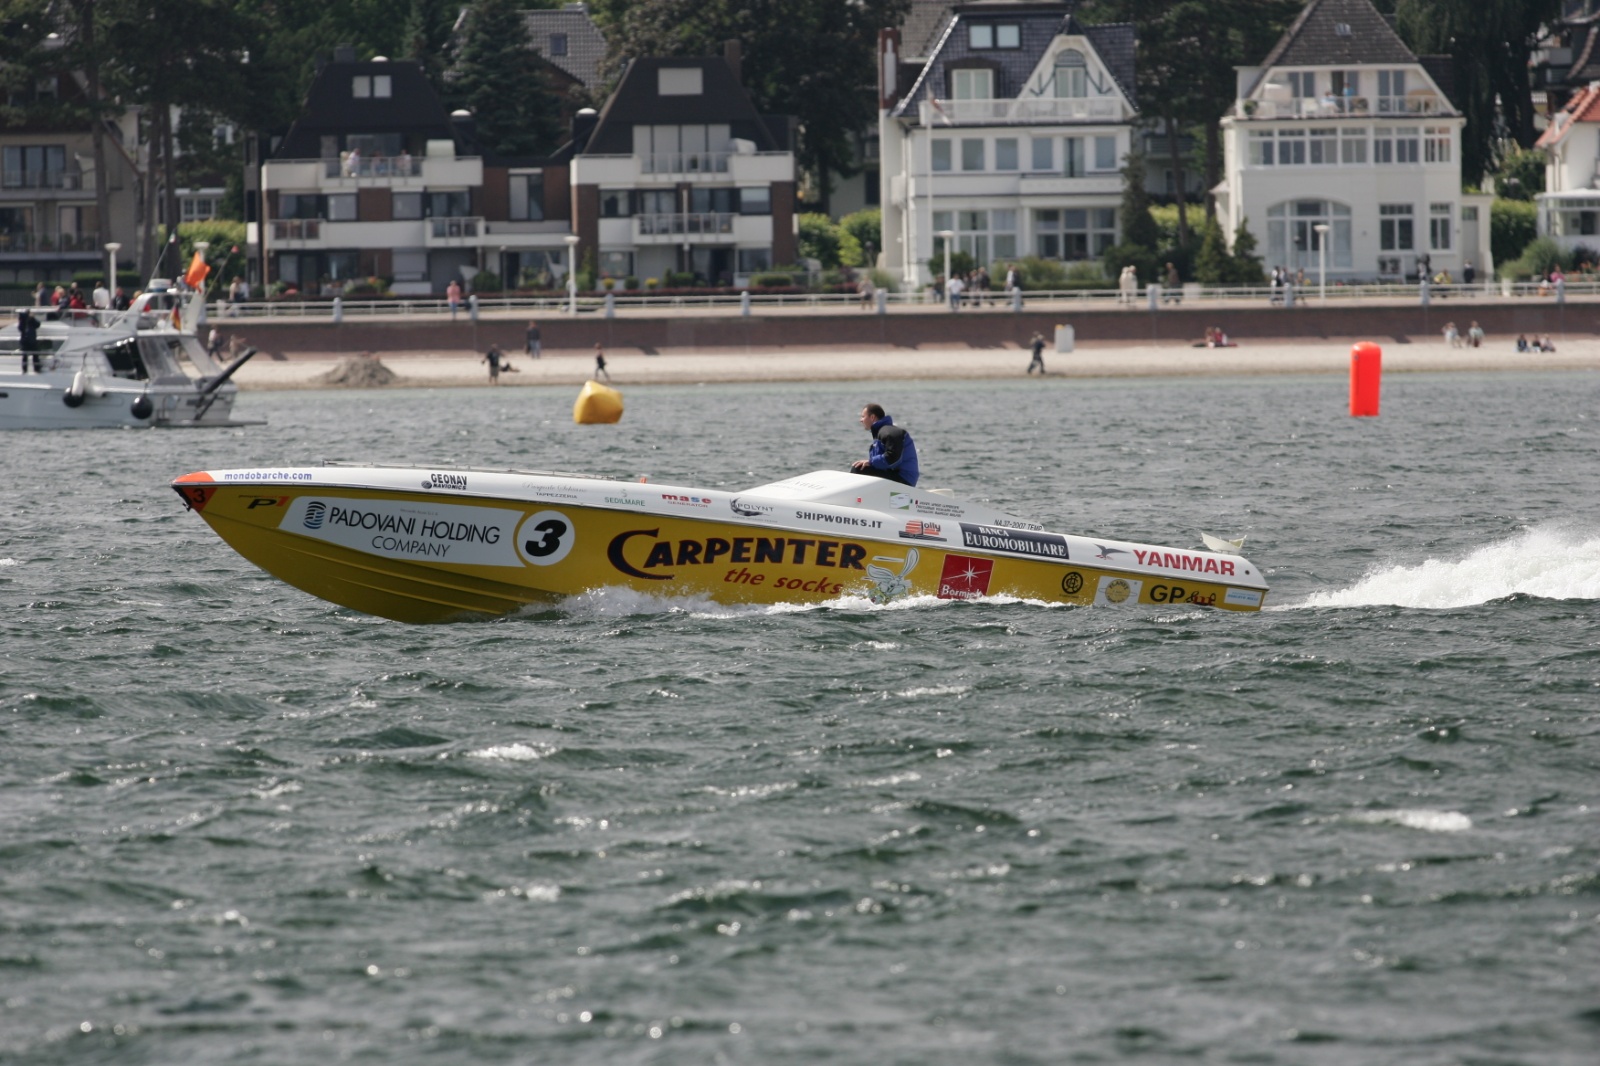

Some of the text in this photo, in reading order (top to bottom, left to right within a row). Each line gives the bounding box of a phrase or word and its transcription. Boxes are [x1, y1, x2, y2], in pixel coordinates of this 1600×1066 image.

[224, 471, 312, 480] mondobarche.com
[431, 473, 468, 486] GEONAV
[193, 488, 206, 504] 3
[604, 496, 646, 506] SEDILMARE
[662, 494, 712, 504] mase
[329, 507, 500, 544] PADOVANI HOLDING
[796, 510, 883, 528] SHIPWORKS.IT
[525, 519, 568, 557] 3
[978, 526, 1010, 537] BANCA
[372, 536, 451, 558] COMPANY
[965, 531, 1067, 557] EUROMOBILIARE
[606, 527, 866, 580] CARPENTER
[1133, 549, 1235, 576] YANMAR
[724, 568, 766, 586] the
[773, 576, 844, 595] socks
[1150, 584, 1185, 604] GP
